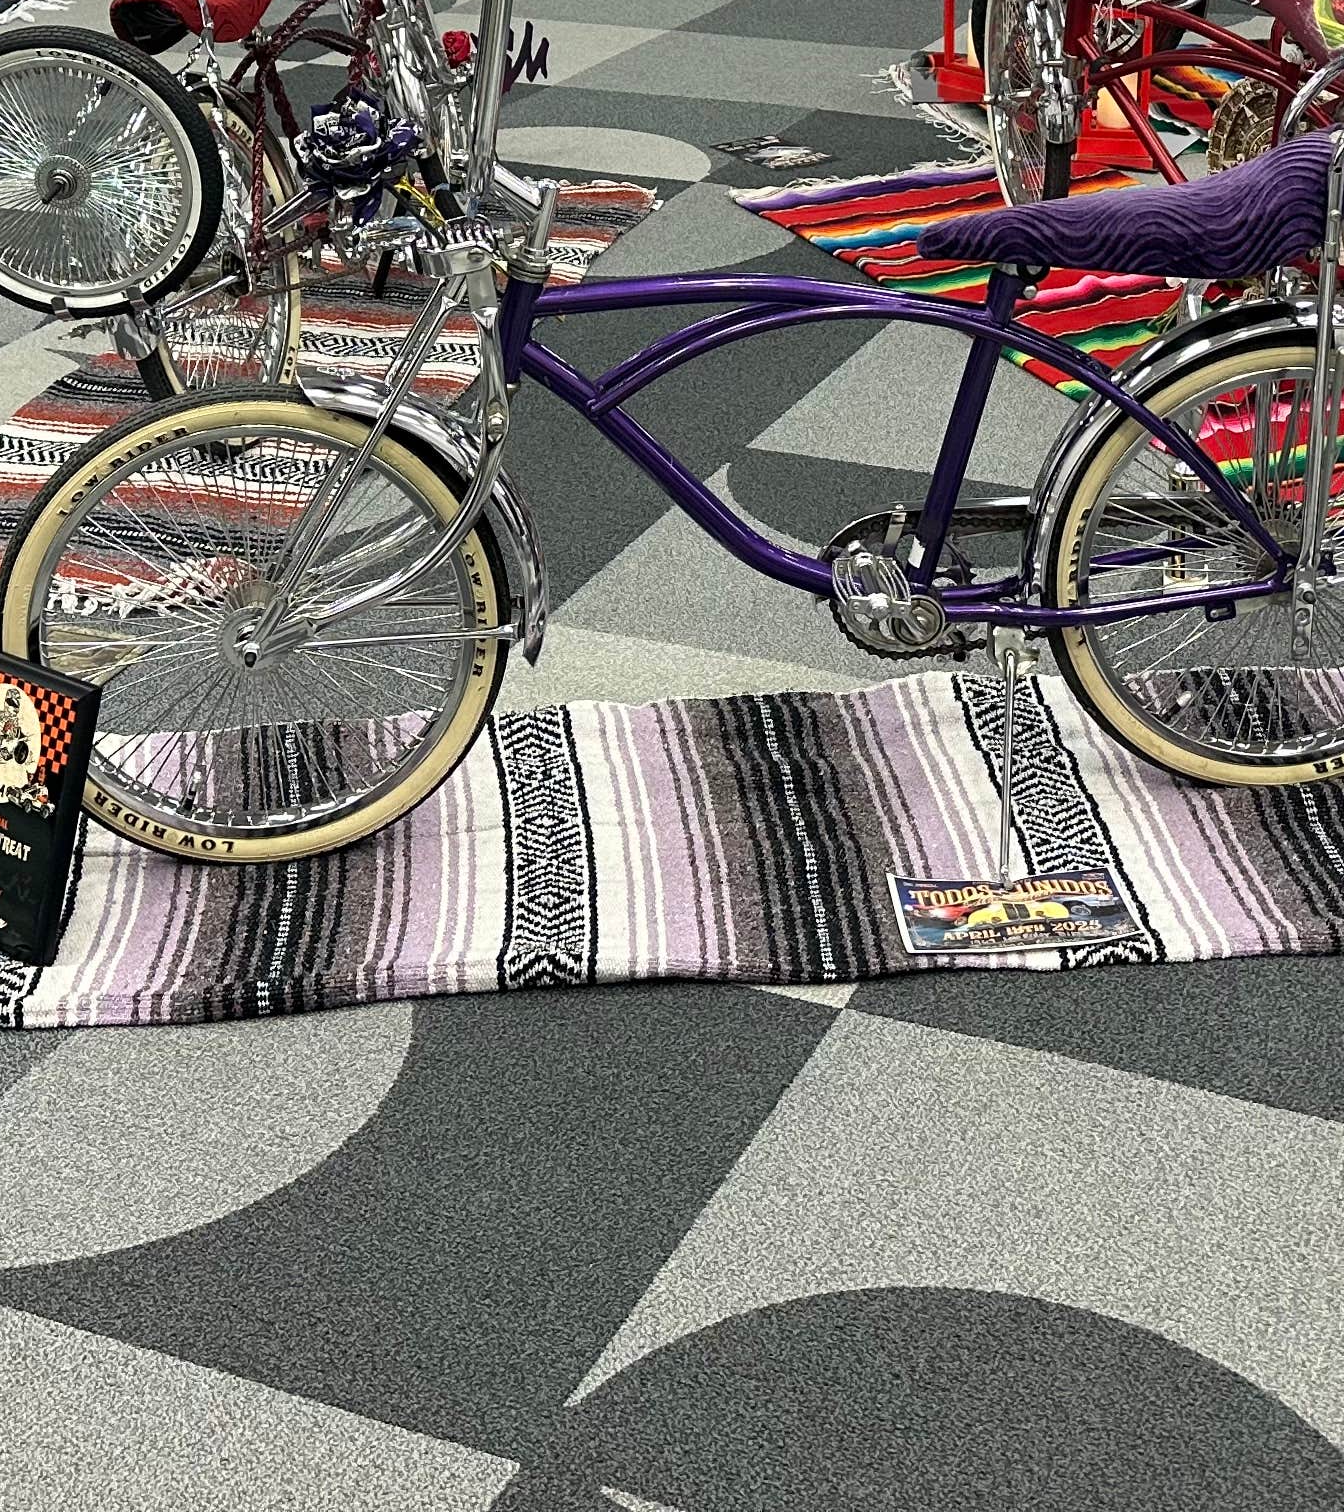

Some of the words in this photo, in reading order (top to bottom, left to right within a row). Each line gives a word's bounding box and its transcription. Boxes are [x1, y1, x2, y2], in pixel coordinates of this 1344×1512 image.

[56, 473, 99, 516] LOW
[108, 426, 188, 469] RIDER
[94, 791, 169, 840] RIDER
[178, 834, 236, 854] LOW
[908, 883, 993, 907] TODOS
[943, 928, 1002, 942] APRIL
